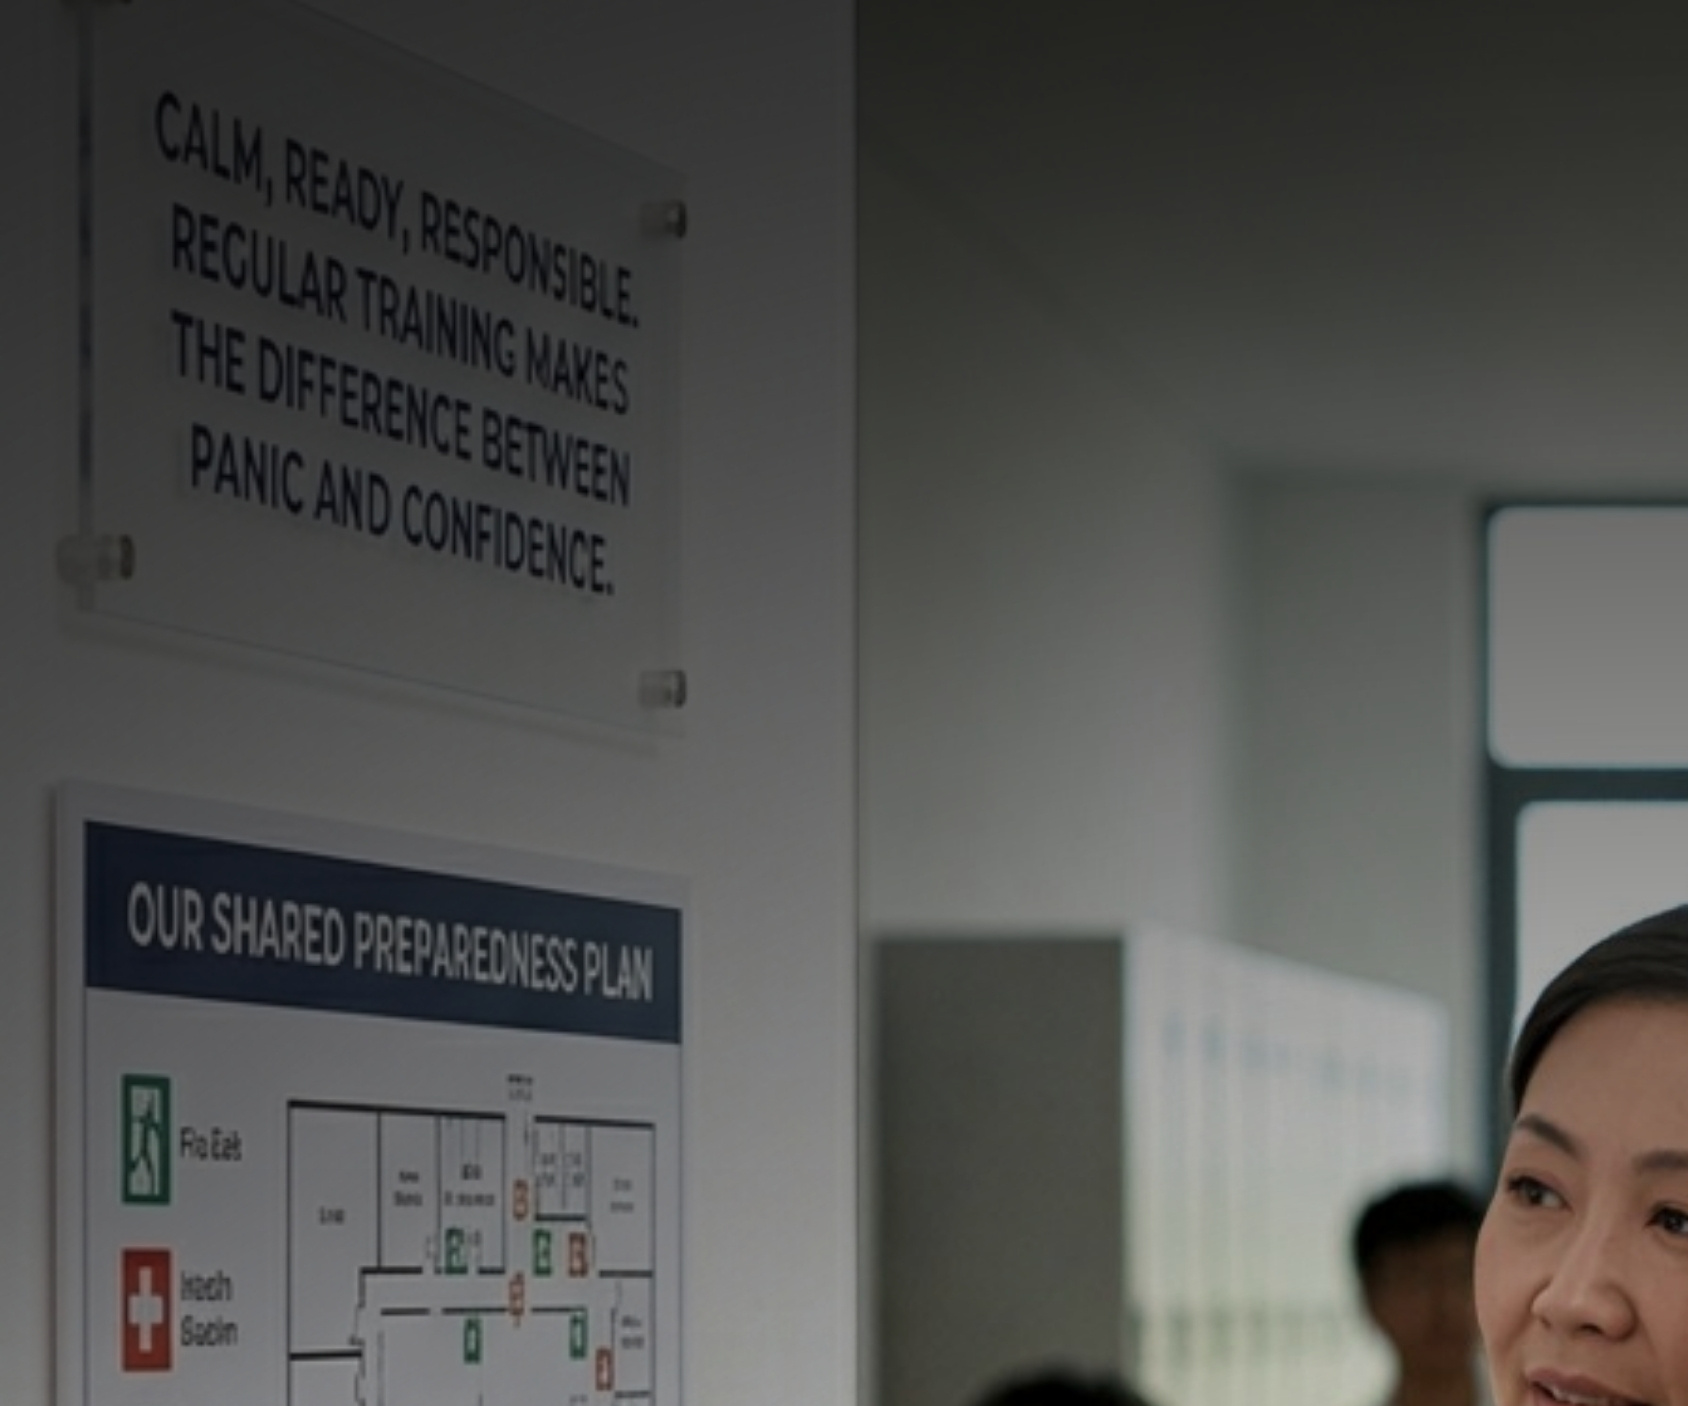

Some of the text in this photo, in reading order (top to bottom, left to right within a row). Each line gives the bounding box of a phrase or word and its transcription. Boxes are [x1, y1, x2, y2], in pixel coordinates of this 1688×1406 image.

[155, 92, 639, 328] CALM, READY, RESPONSIBLE.
[172, 204, 629, 414] REGULAR TRAINING MAKES
[171, 311, 630, 505] THE DIFFERENCE BETWEEN
[192, 425, 614, 594] PANIC AND CONFIDENCE.
[127, 881, 654, 1001] OUR SHARED PREPAREDNESS PLAN
